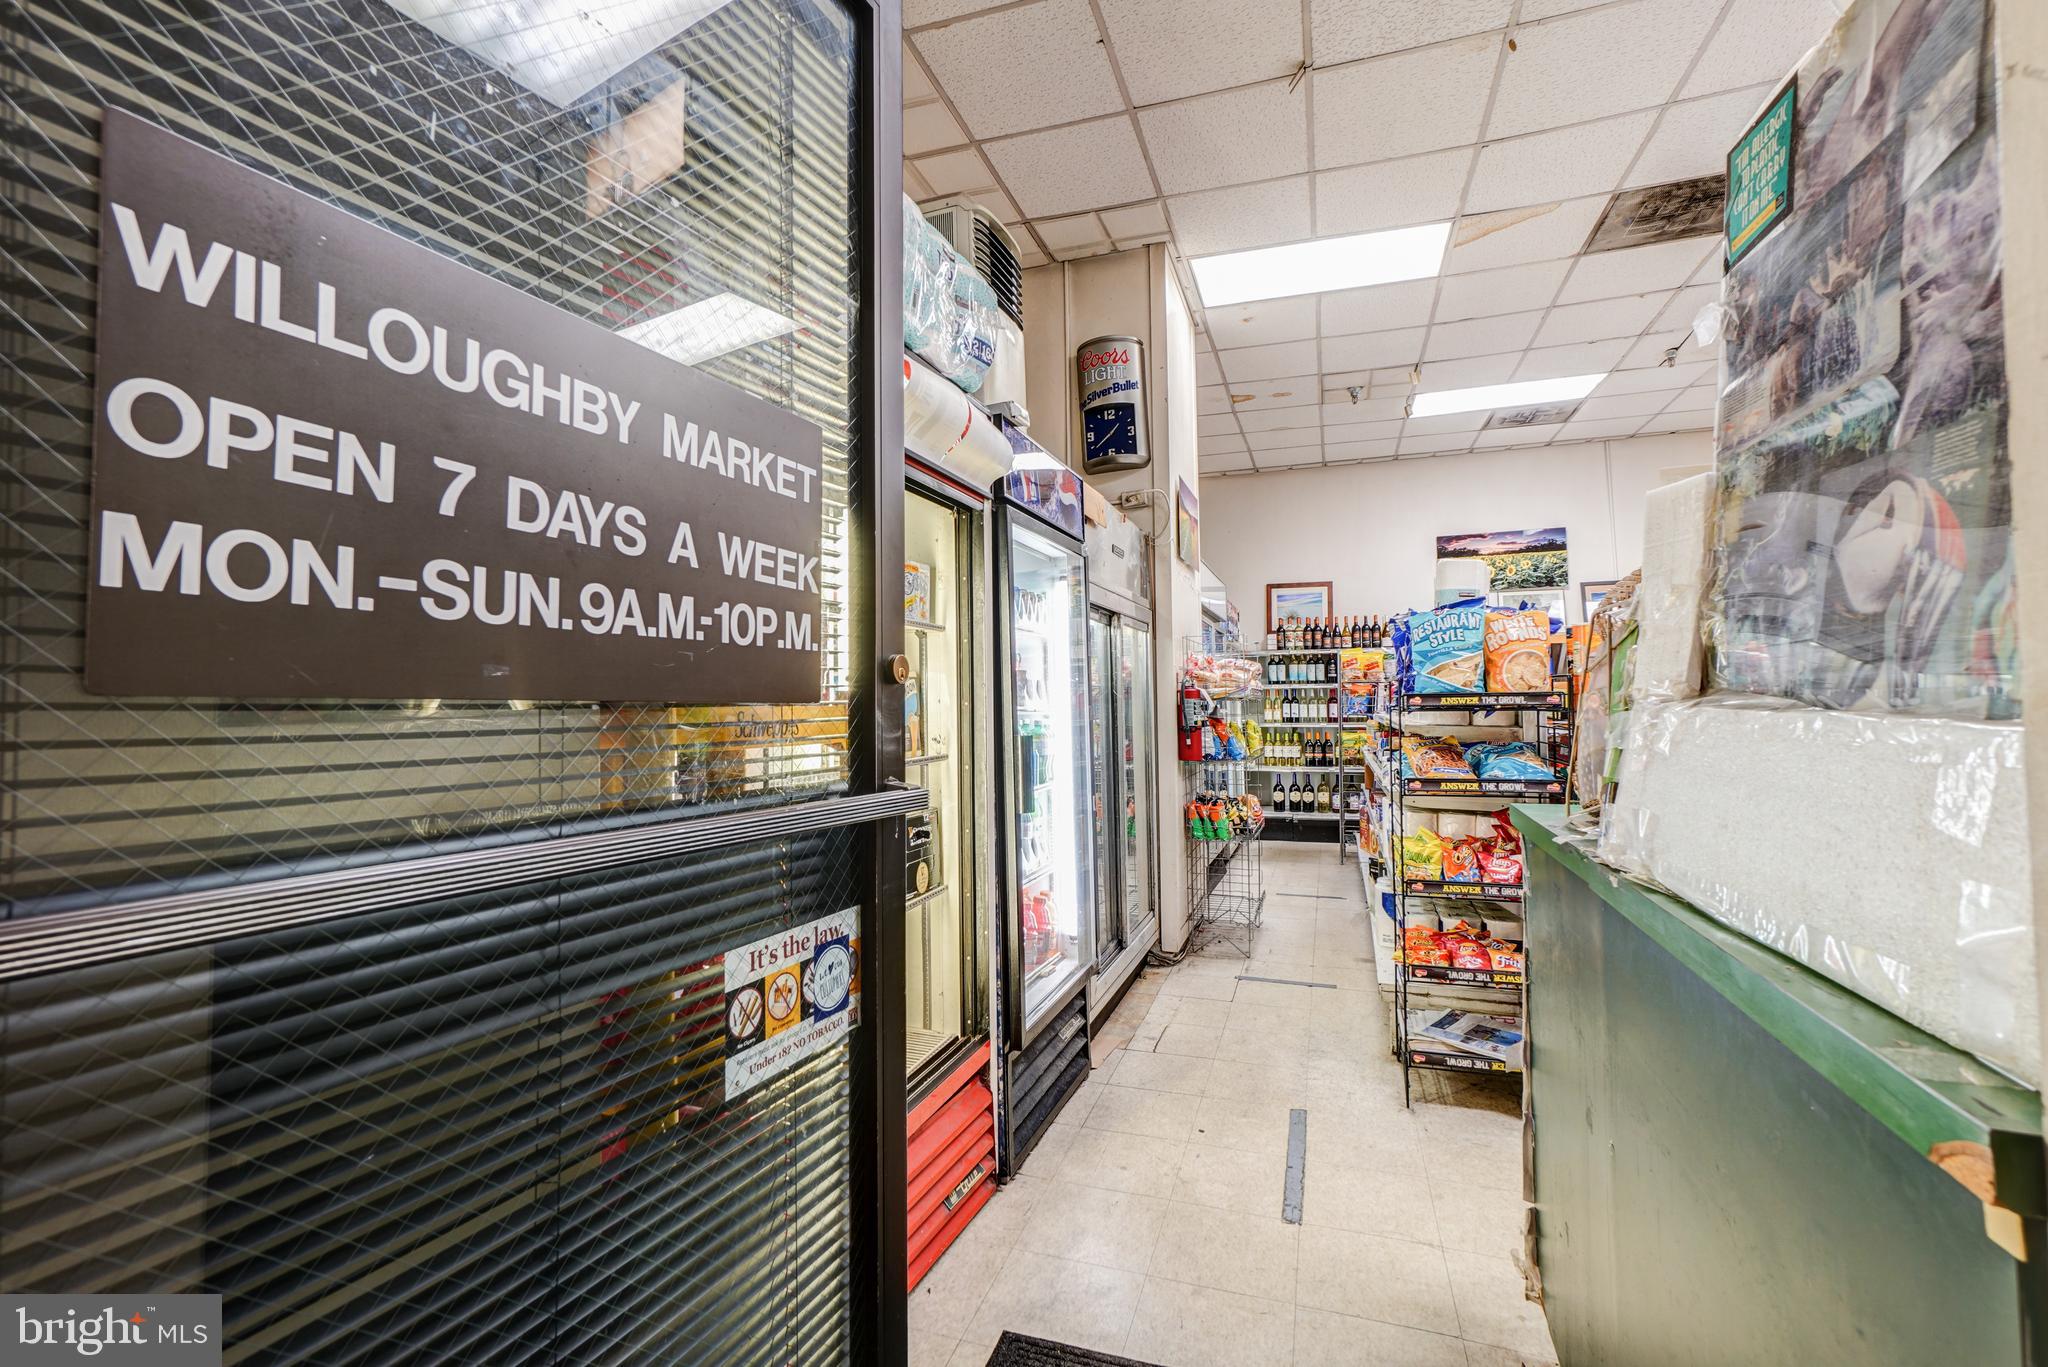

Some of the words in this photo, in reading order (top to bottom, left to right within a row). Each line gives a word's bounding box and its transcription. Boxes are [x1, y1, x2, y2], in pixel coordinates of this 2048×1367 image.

[110, 202, 640, 446] WILLOUGHBY
[663, 413, 818, 504] MARKET
[1080, 347, 1130, 372] Coors
[1084, 365, 1127, 384] LIGHT
[1104, 409, 1115, 420] 12
[1127, 426, 1135, 436] 3
[1087, 432, 1094, 442] 9
[107, 377, 395, 504] OPEN
[433, 455, 477, 518] 7
[507, 476, 647, 558] DAYS
[668, 522, 699, 570] A
[718, 531, 820, 595] WEEK
[1412, 612, 1481, 645] RESTAURANT
[1429, 629, 1465, 648] STYLE
[1440, 696, 1480, 704] ANSWER
[1481, 696, 1498, 704] THE
[1498, 696, 1527, 704] GROWL
[1440, 782, 1479, 791] ANSWER
[1481, 782, 1498, 791] THE
[1498, 782, 1527, 791] GROWL
[1443, 885, 1482, 894] ANSWER
[1484, 886, 1501, 895] THE
[1501, 887, 1523, 896] GROW
[750, 945, 778, 973] It's
[782, 932, 810, 958] the
[814, 922, 844, 947] law.
[1447, 971, 1474, 980] GROWL
[1474, 973, 1491, 981] THE
[1493, 974, 1522, 983] SWER
[750, 1056, 777, 1075] Under
[793, 1037, 806, 1053] NO
[1445, 1057, 1473, 1067] GROWL
[1474, 1060, 1490, 1069] THE
